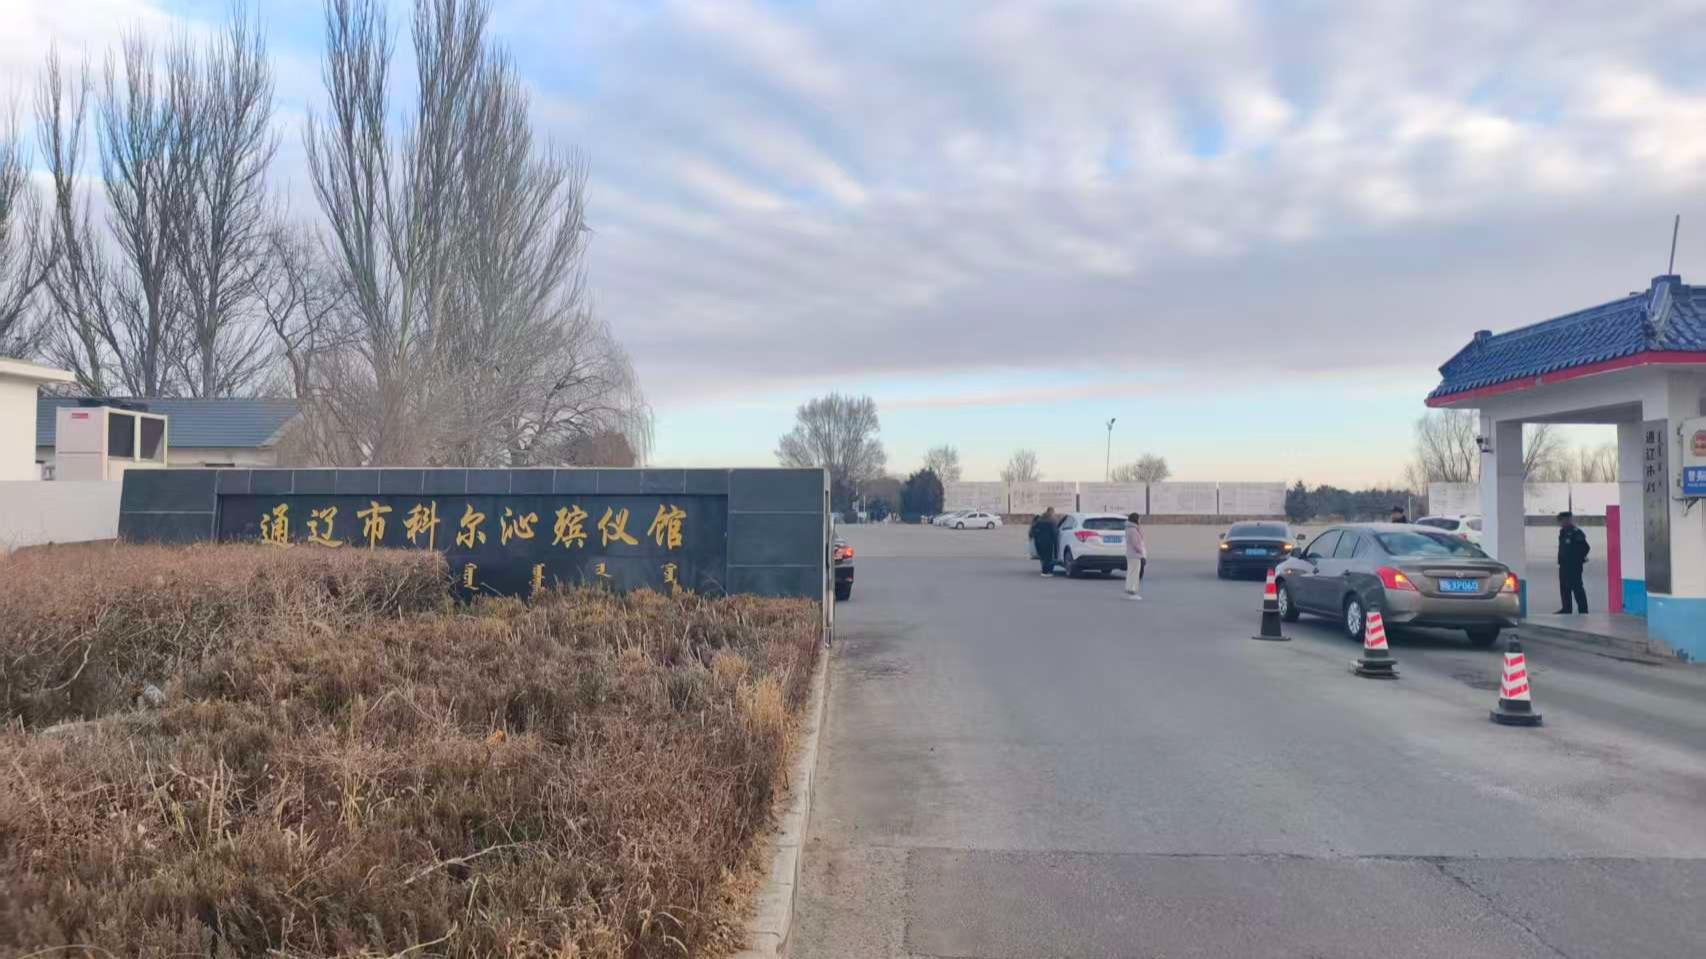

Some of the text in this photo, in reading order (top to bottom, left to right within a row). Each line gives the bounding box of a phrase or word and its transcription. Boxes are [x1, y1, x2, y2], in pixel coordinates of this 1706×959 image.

[260, 501, 688, 552] 通辽市科尔沁殡仪馆
